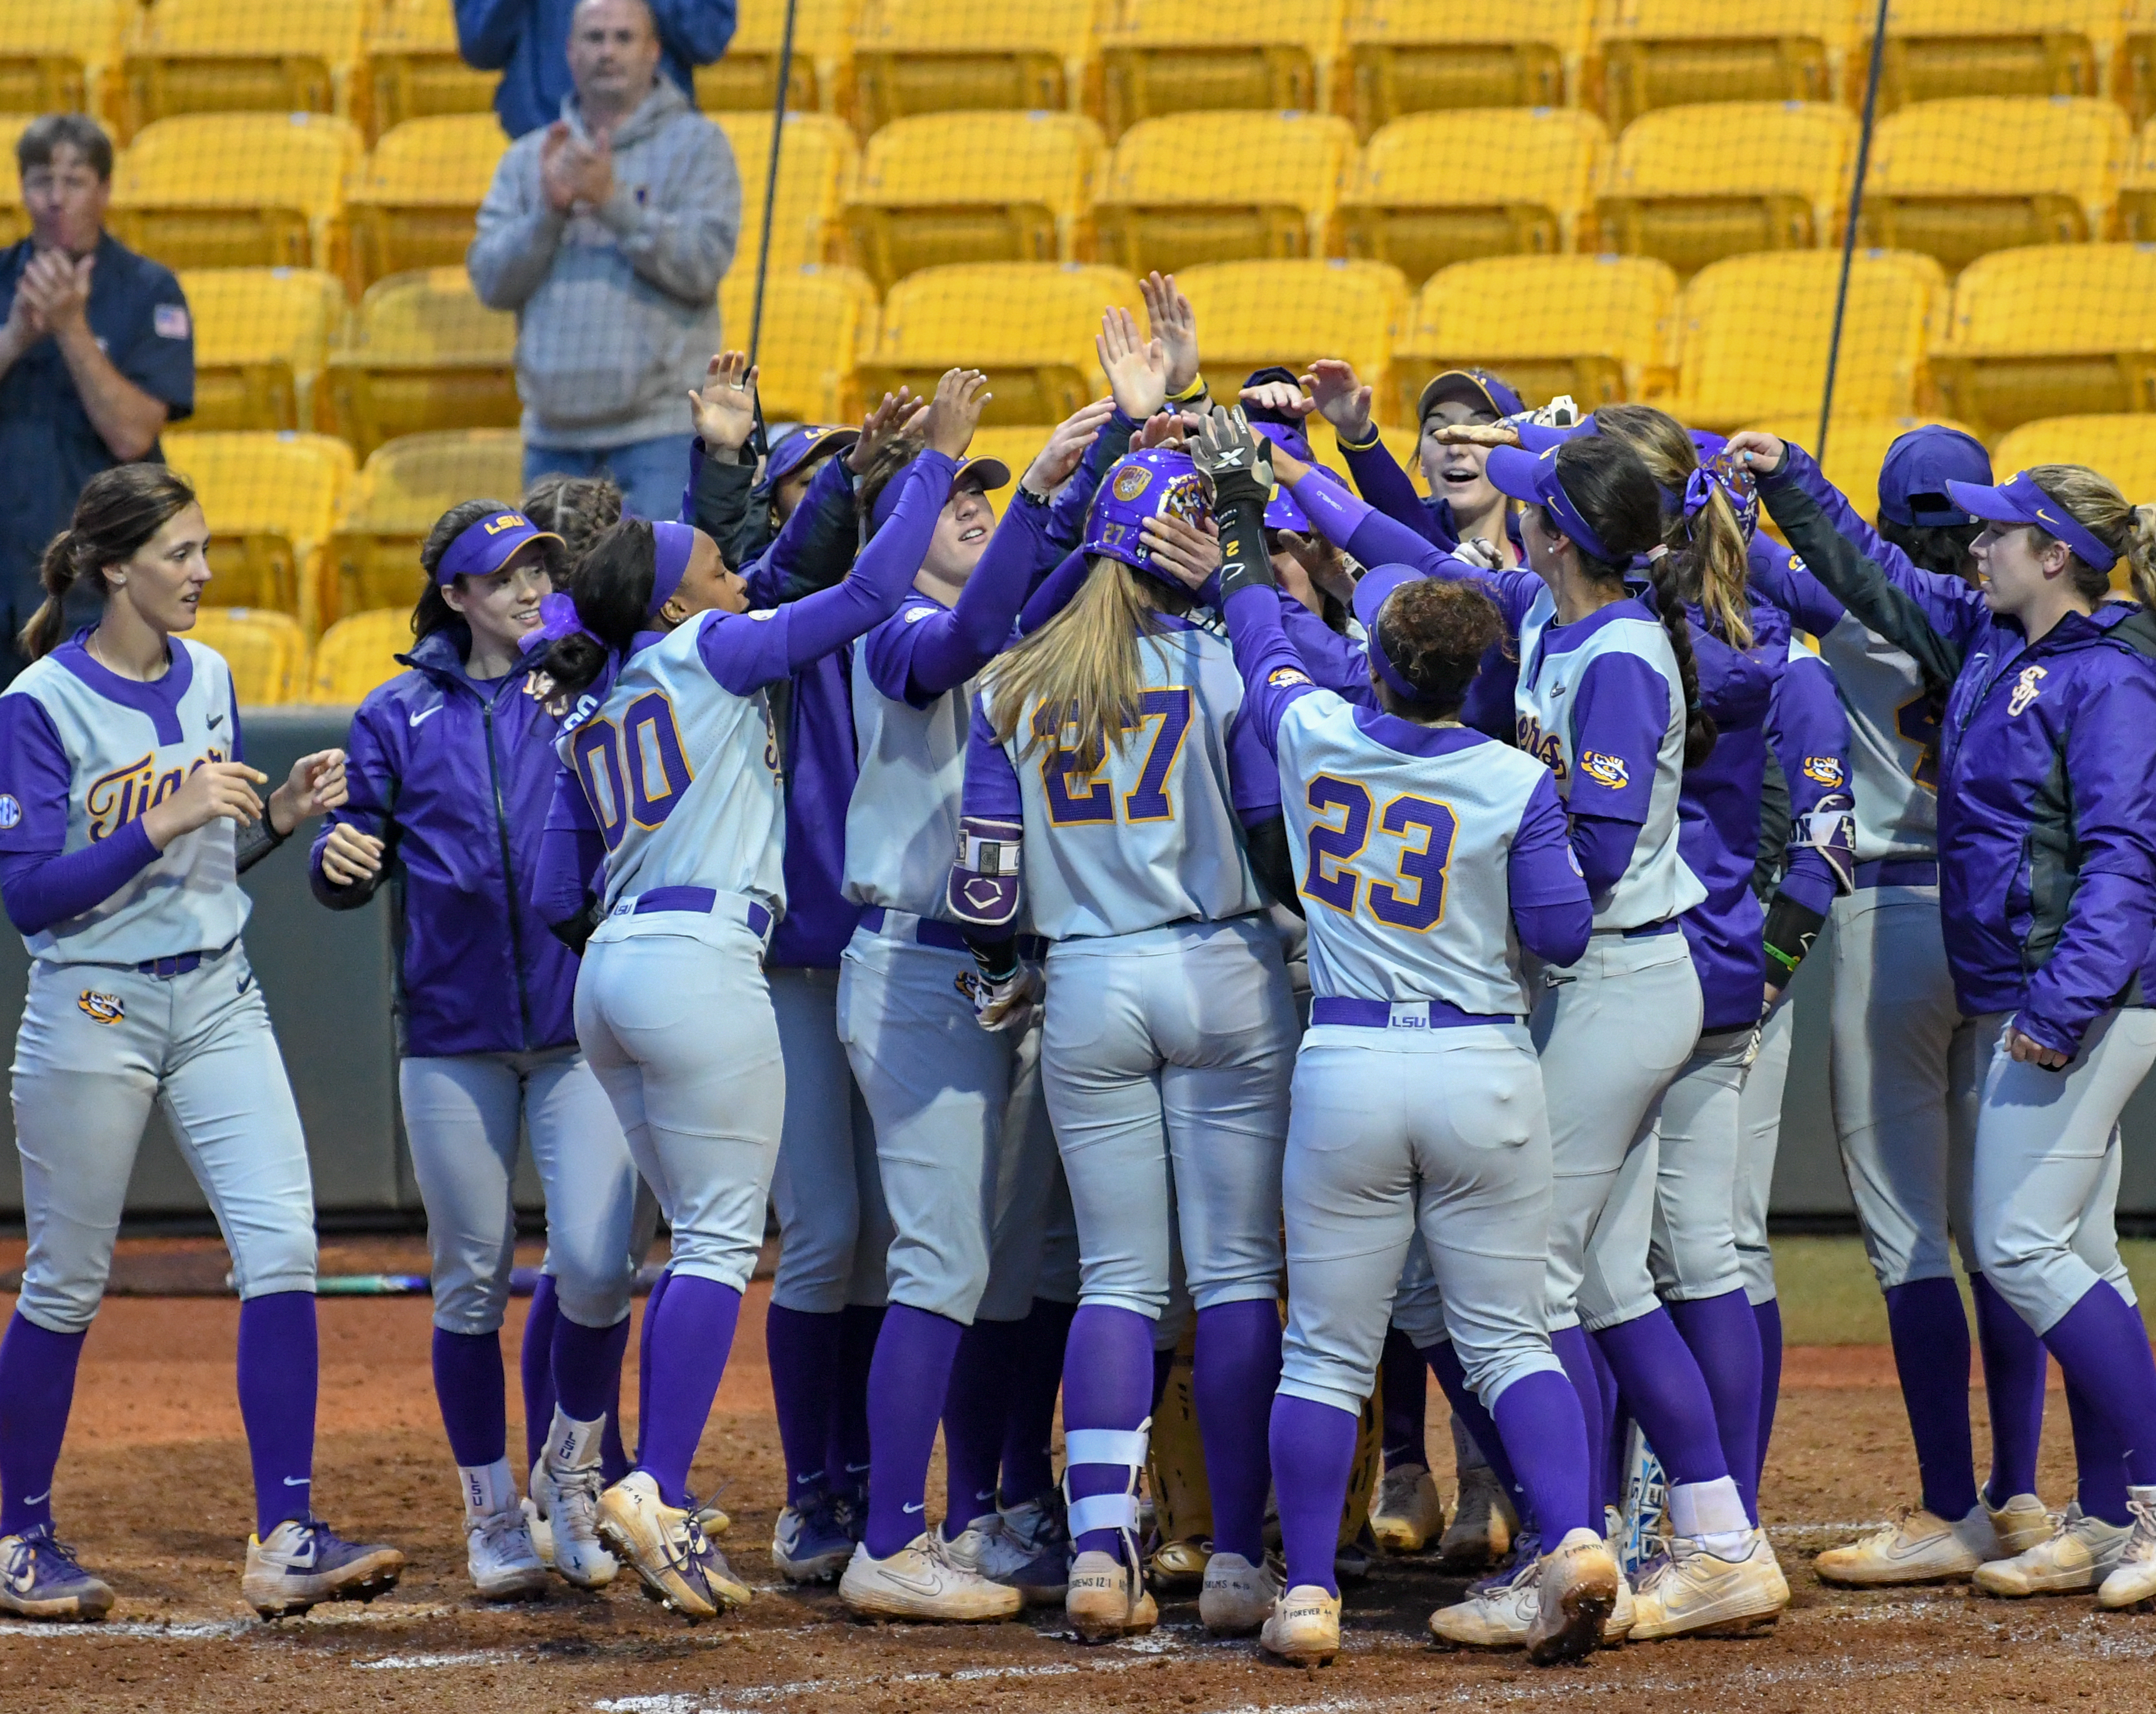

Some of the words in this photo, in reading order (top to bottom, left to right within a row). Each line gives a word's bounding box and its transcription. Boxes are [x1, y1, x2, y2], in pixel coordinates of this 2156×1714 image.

[483, 515, 525, 536] LSU
[1102, 523, 1126, 545] 27
[1029, 685, 1194, 828] 27
[569, 688, 695, 855] 00
[1296, 770, 1461, 935] 23
[613, 903, 633, 916] LSU
[1392, 1016, 1427, 1028] LSU
[558, 1431, 576, 1460] LSU
[469, 1473, 483, 1507] LSU
[1289, 1607, 1321, 1618] FOREVER
